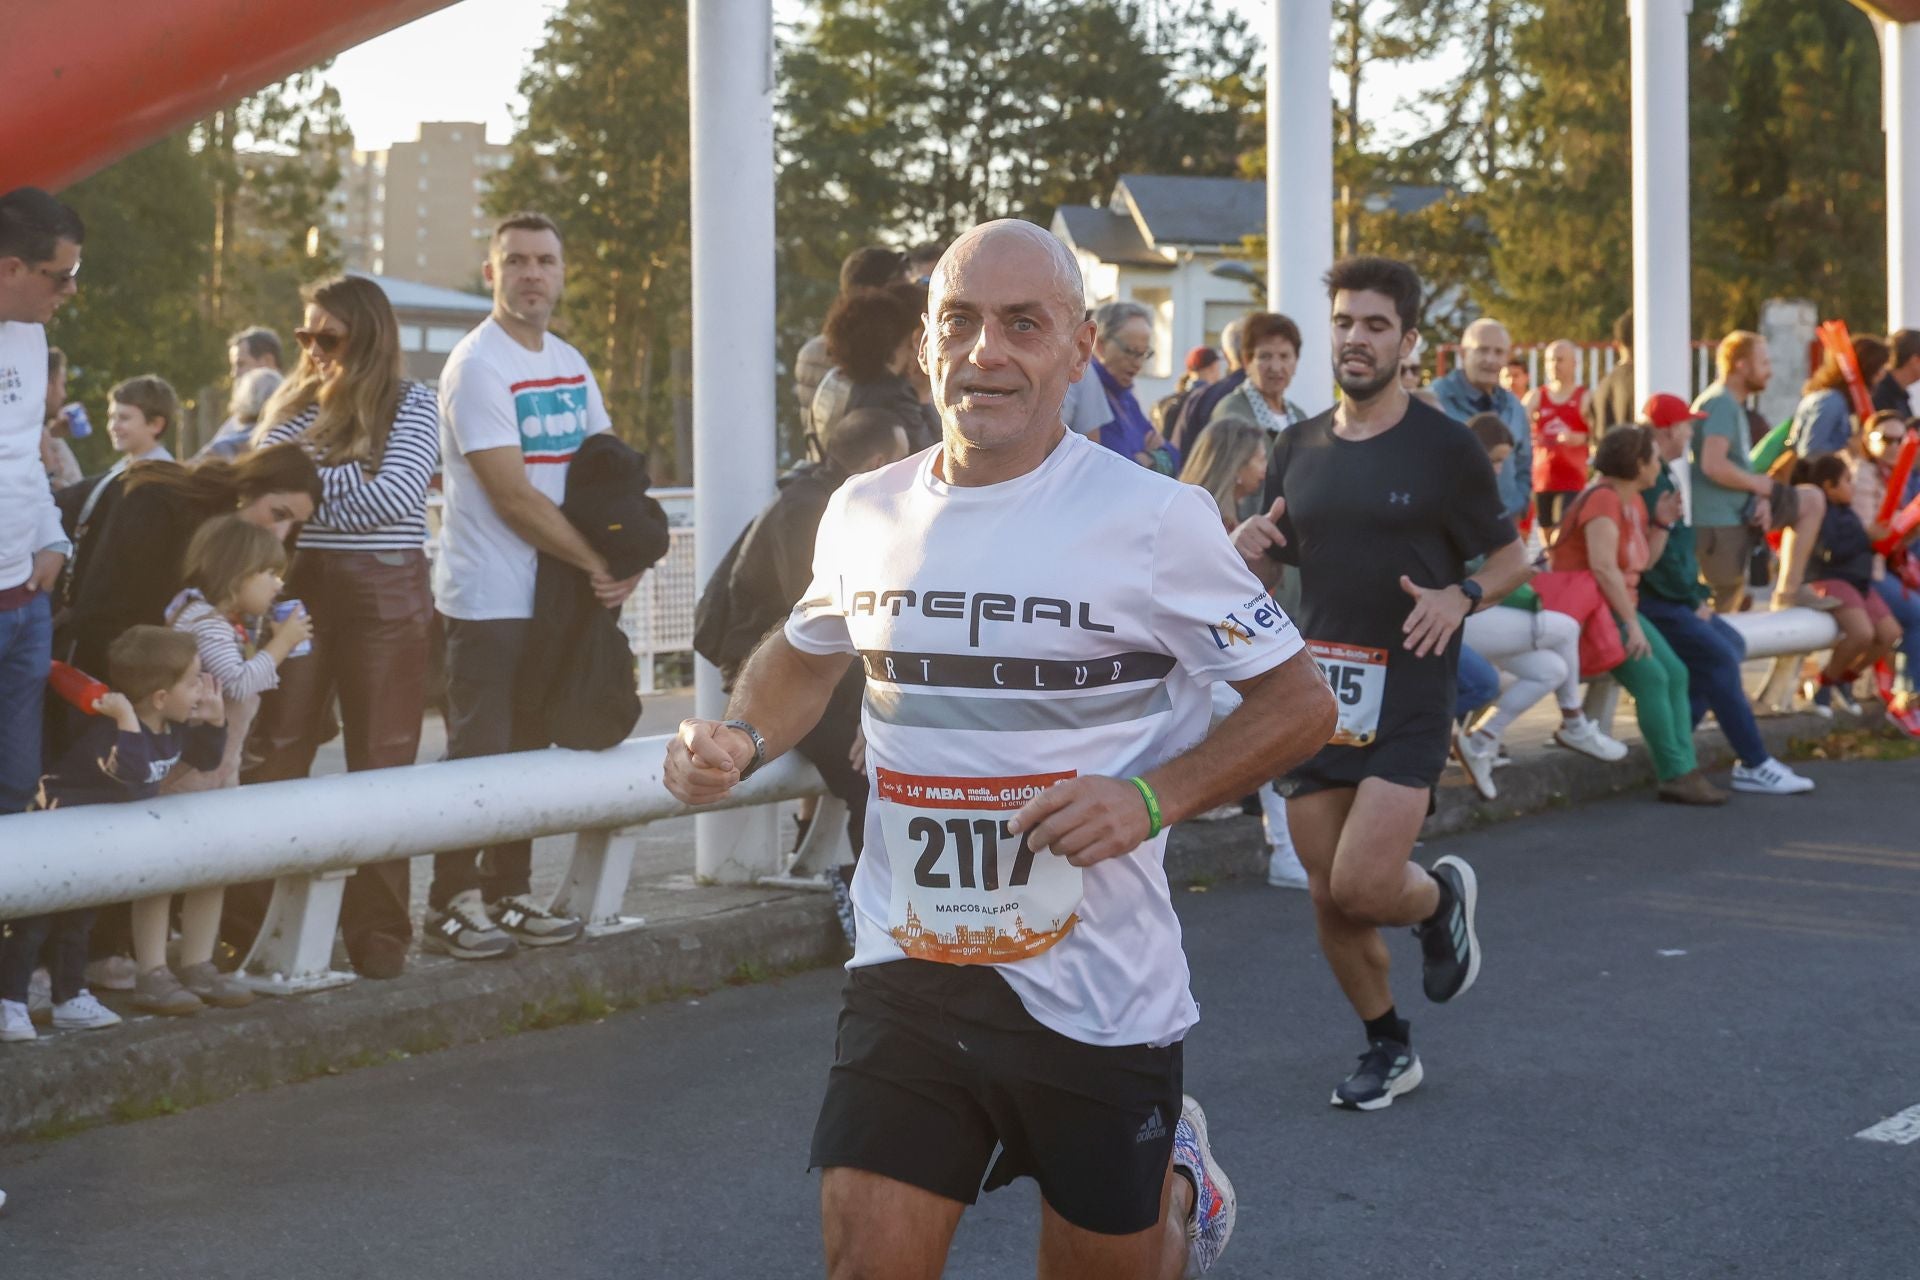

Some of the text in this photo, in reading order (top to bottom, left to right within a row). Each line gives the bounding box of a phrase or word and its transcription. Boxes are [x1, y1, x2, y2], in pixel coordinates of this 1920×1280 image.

[843, 589, 1115, 647] ATERAL
[993, 660, 1122, 687] CLUB
[1318, 663, 1365, 705] 15
[925, 787, 966, 801] MBA
[967, 787, 991, 796] media
[968, 794, 1000, 803] maratón
[908, 816, 1038, 891] 2117
[936, 902, 1019, 915] MARCOS ALFARO
